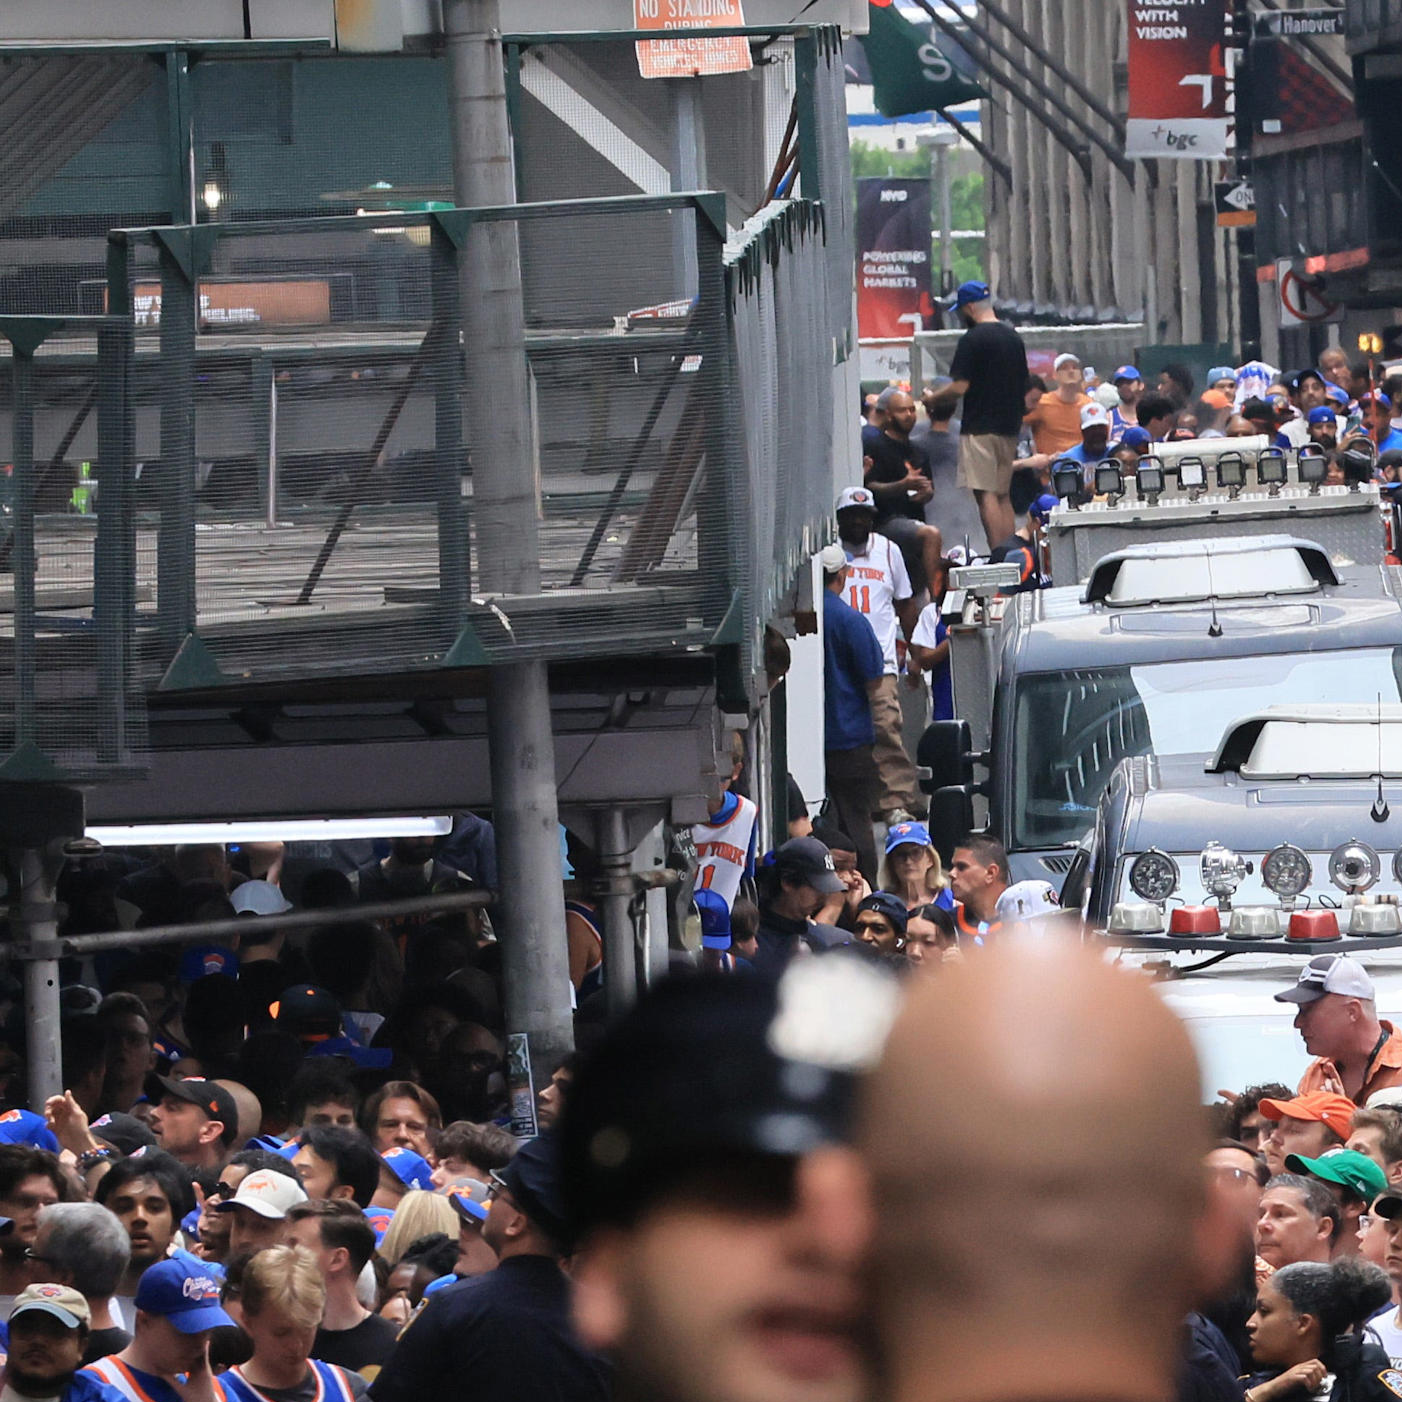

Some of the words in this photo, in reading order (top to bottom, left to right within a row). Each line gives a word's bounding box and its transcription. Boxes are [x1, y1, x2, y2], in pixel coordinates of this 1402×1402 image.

[640, 0, 658, 18] NO
[669, 0, 735, 17] STANDING
[1135, 10, 1178, 22] WITH
[1284, 16, 1336, 32] Hanover
[1136, 26, 1187, 40] VISION
[1166, 130, 1198, 152] bgc
[863, 264, 908, 275] GLOBAL
[864, 276, 917, 288] MARKETS
[850, 585, 871, 612] 11
